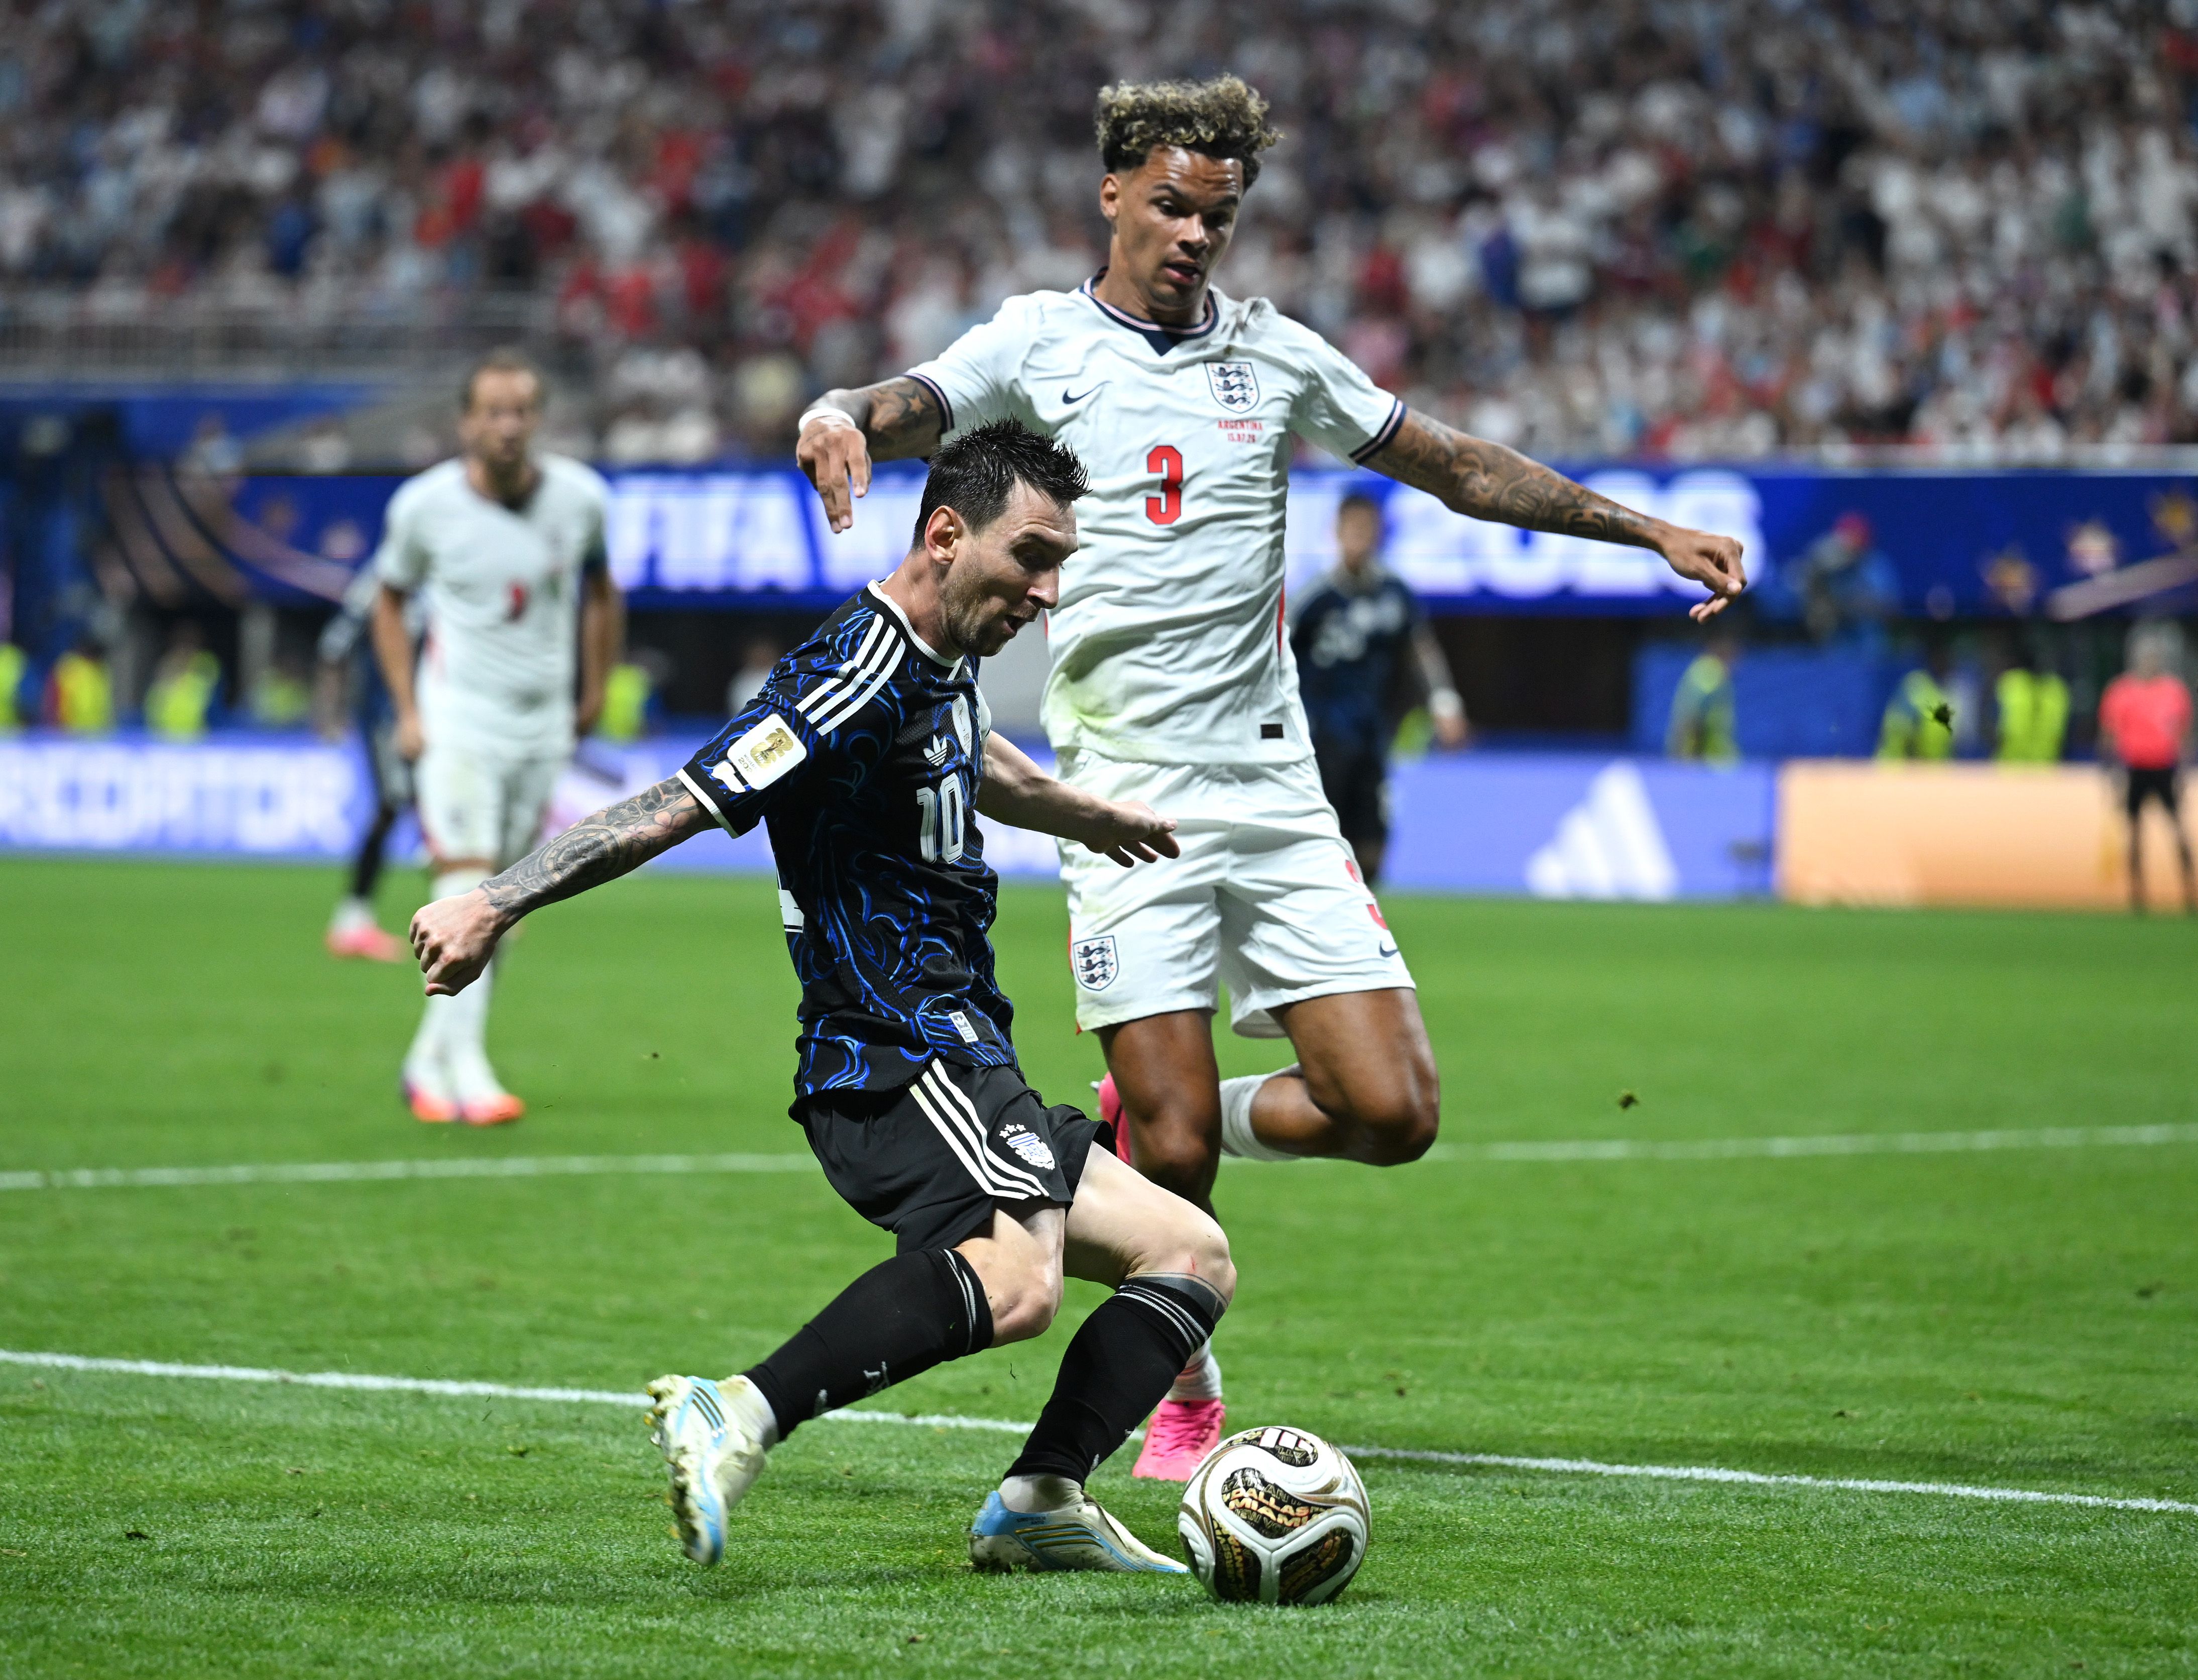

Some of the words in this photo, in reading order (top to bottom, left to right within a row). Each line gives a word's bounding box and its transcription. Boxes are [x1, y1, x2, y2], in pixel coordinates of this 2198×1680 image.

[1218, 420, 1262, 431] ARGENTINA
[1146, 445, 1183, 525] 3
[738, 757, 753, 773] 202
[916, 772, 964, 865] 10
[1228, 1497, 1309, 1528] MIAMI
[1230, 1487, 1310, 1517] DALLAS
